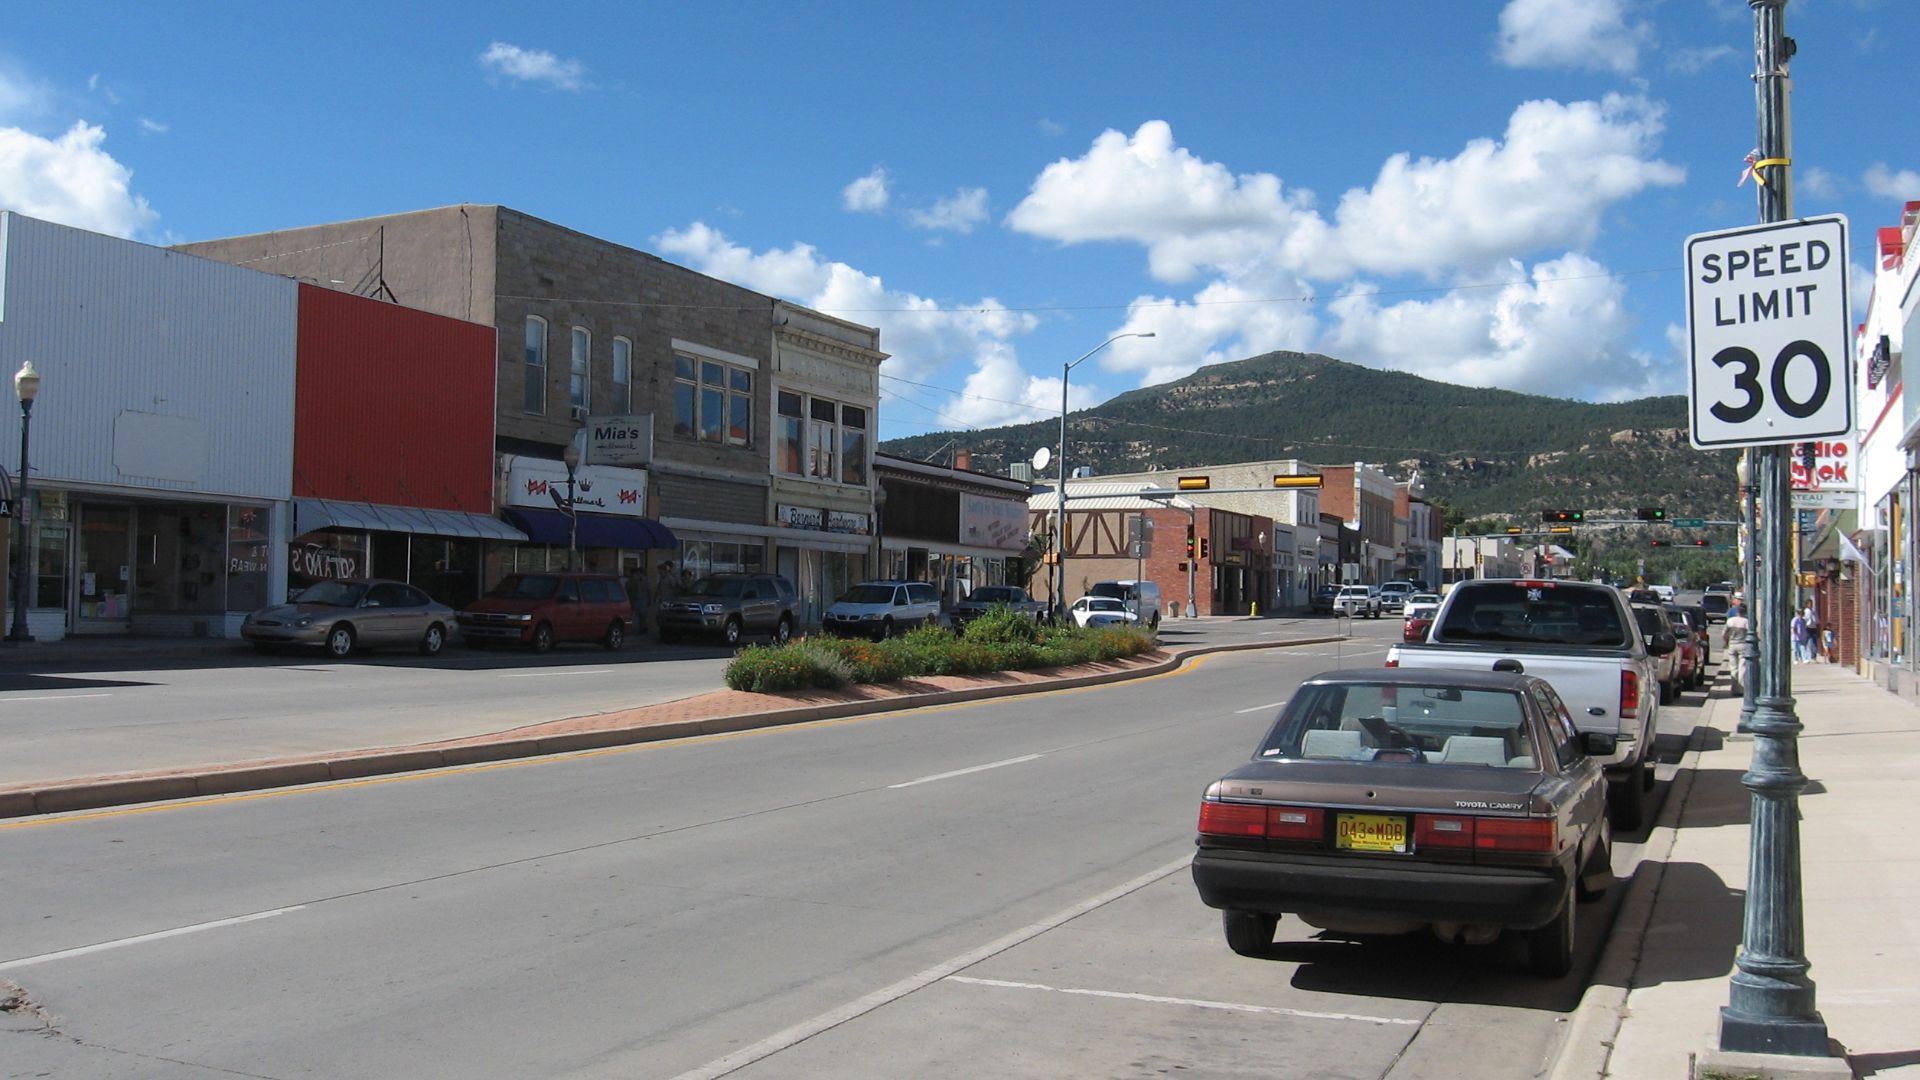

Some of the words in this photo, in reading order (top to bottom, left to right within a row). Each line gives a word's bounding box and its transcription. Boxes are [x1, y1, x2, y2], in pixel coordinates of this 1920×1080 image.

[1701, 240, 1830, 284] SPEED
[1714, 284, 1817, 327] LIMIT
[1709, 339, 1831, 424] 30
[594, 427, 639, 441] Mia's
[1455, 800, 1488, 808] TOYOTA
[1489, 802, 1524, 810] CAMRY
